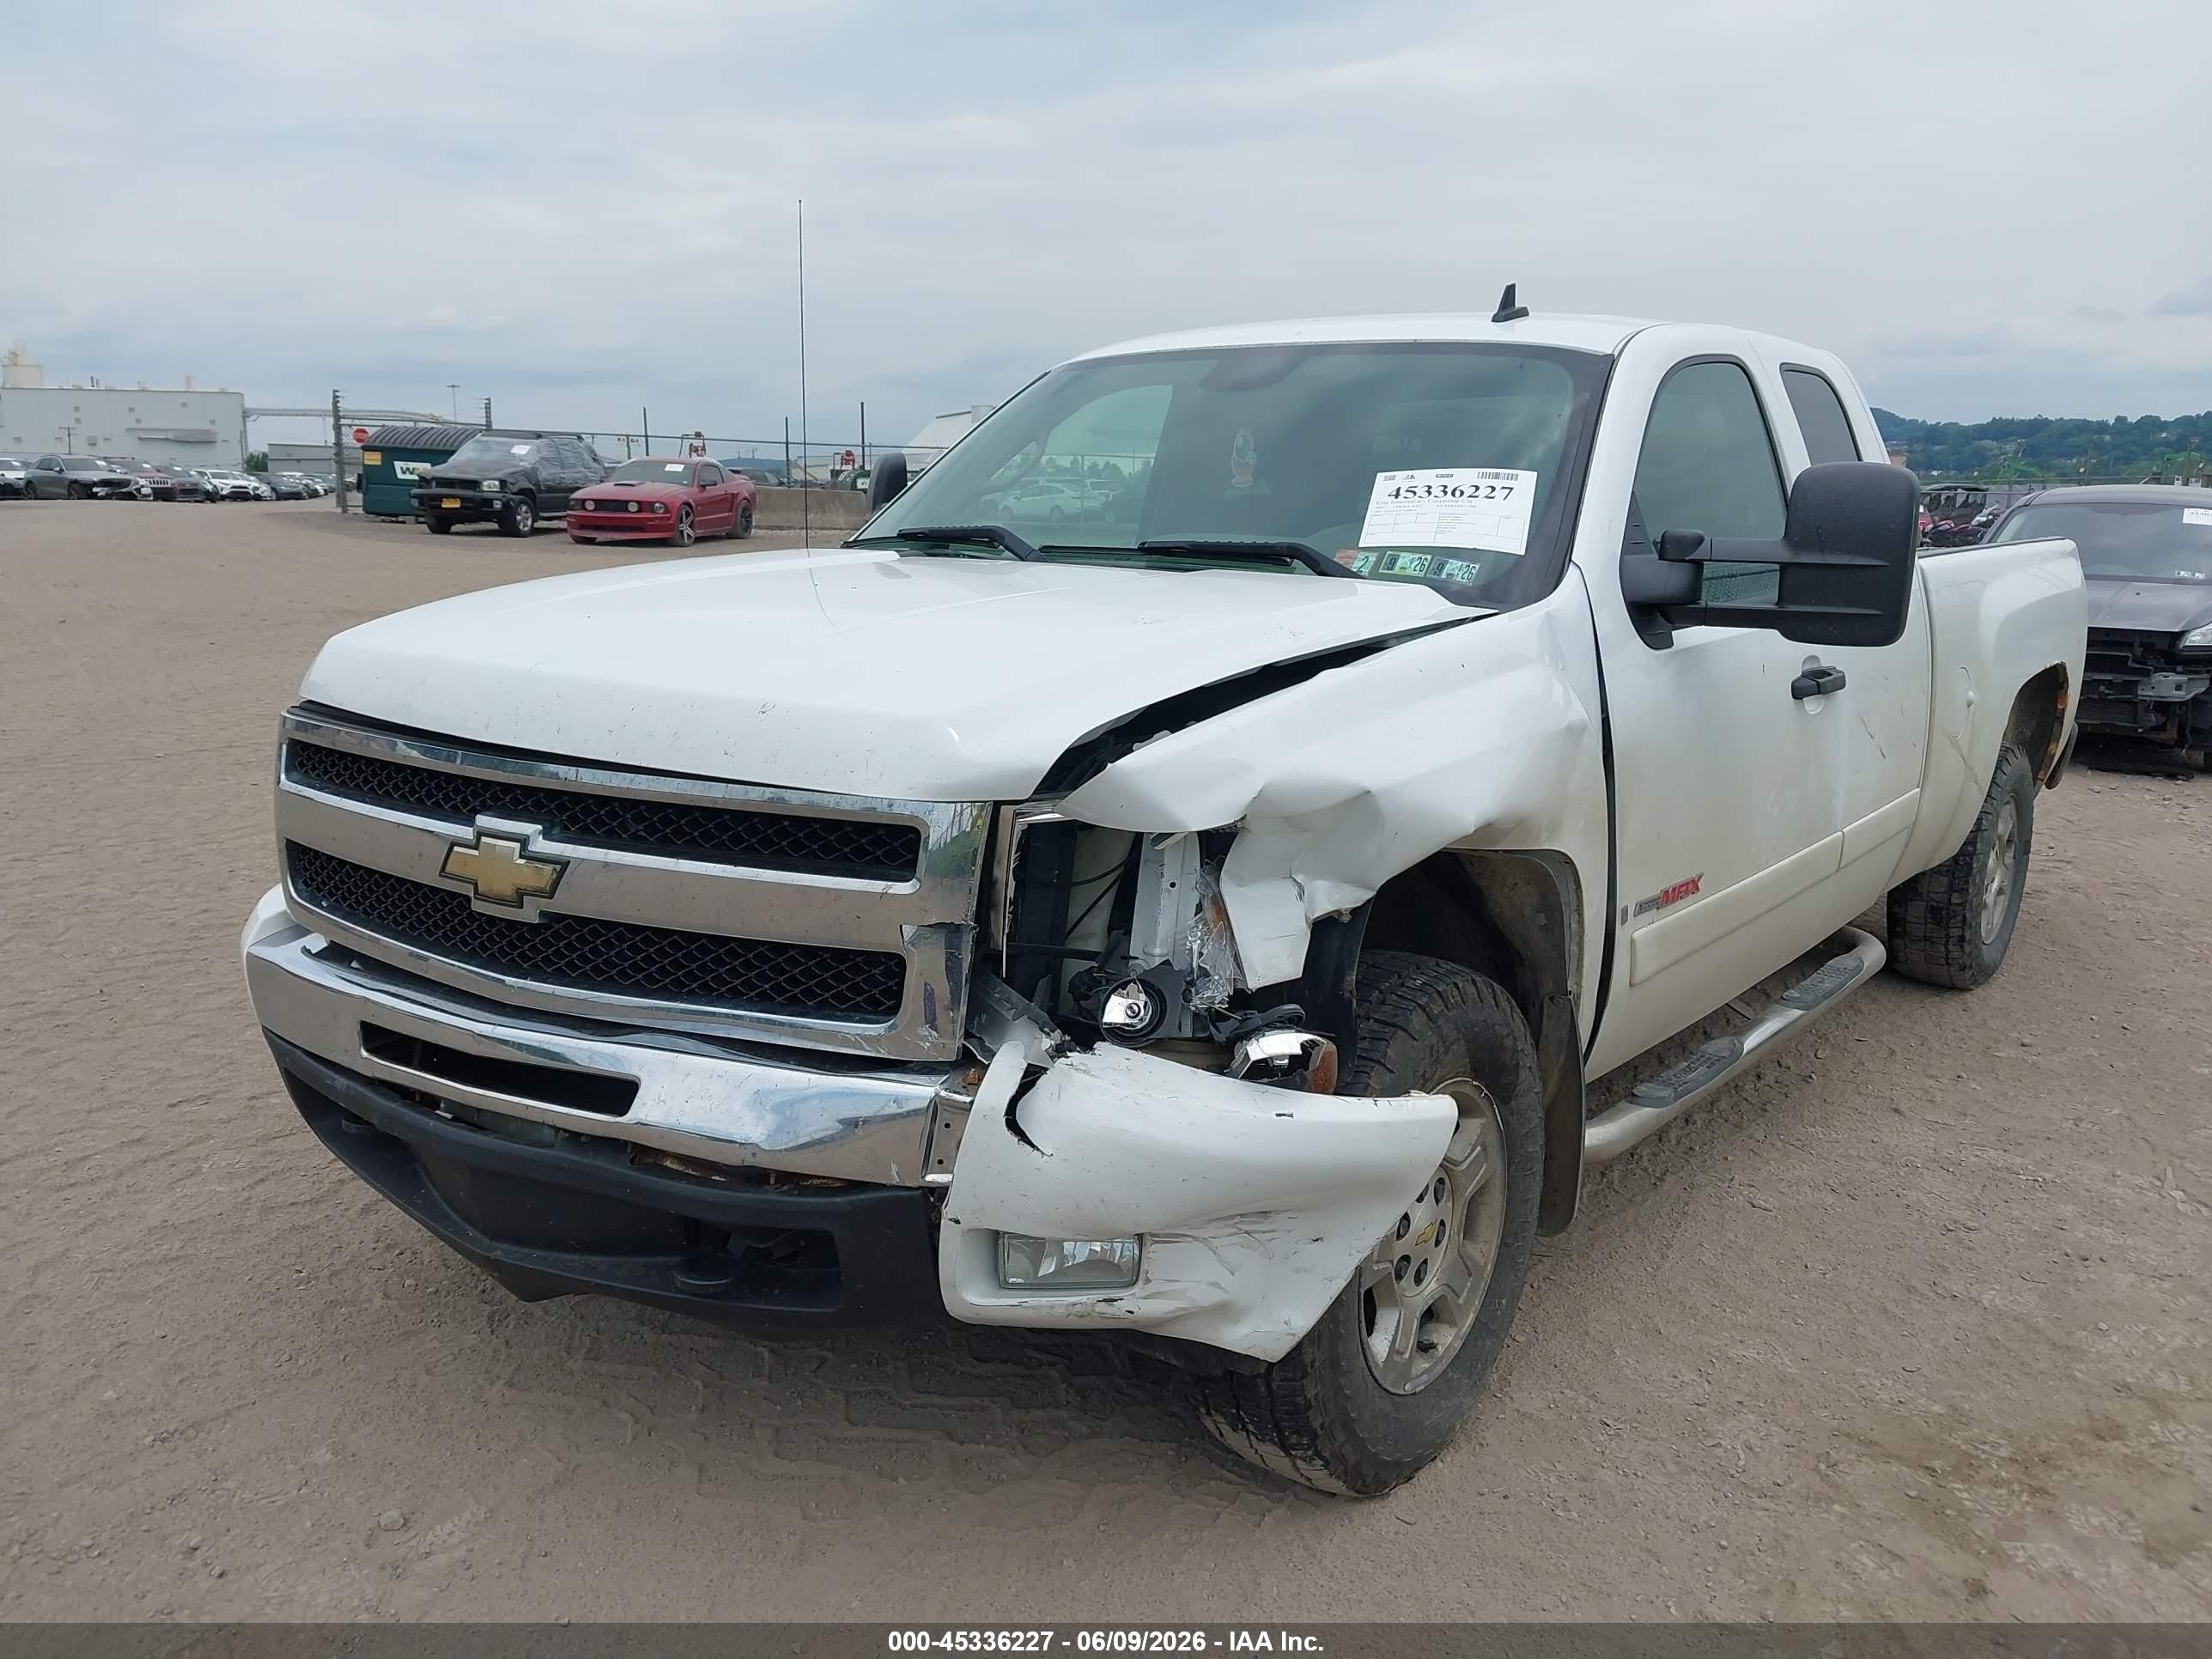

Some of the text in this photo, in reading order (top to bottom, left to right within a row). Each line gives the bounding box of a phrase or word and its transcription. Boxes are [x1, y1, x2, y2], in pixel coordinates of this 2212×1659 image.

[1388, 483, 1515, 501] 45336227
[1355, 556, 1370, 574] 2
[1413, 556, 1429, 573] 26
[1461, 564, 1477, 581] 26
